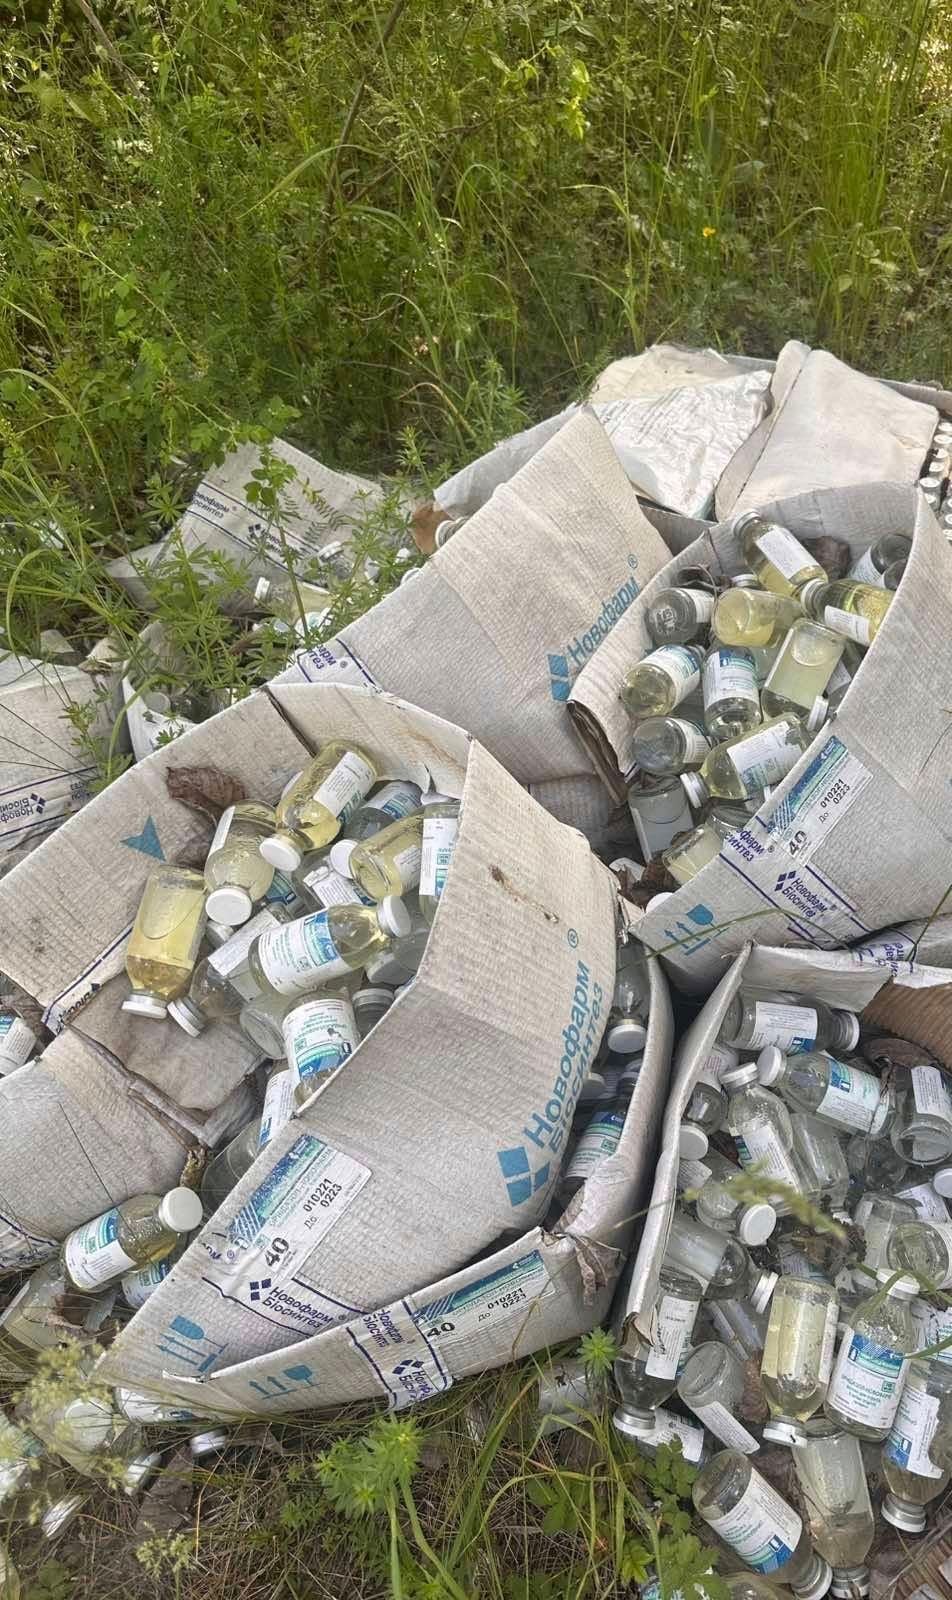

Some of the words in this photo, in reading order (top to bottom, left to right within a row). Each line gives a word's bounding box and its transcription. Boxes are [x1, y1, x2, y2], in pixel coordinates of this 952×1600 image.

[567, 576, 640, 667] Новофарм
[787, 830, 808, 856] 40
[523, 959, 591, 1149] Новофарм
[303, 1177, 335, 1213] 010221
[320, 1183, 343, 1209] 0223
[264, 1236, 290, 1268] 40
[261, 1298, 325, 1329] Біосинтез
[268, 1286, 335, 1323] Новофарм
[486, 1287, 525, 1311] 010221
[426, 1321, 457, 1339] 40
